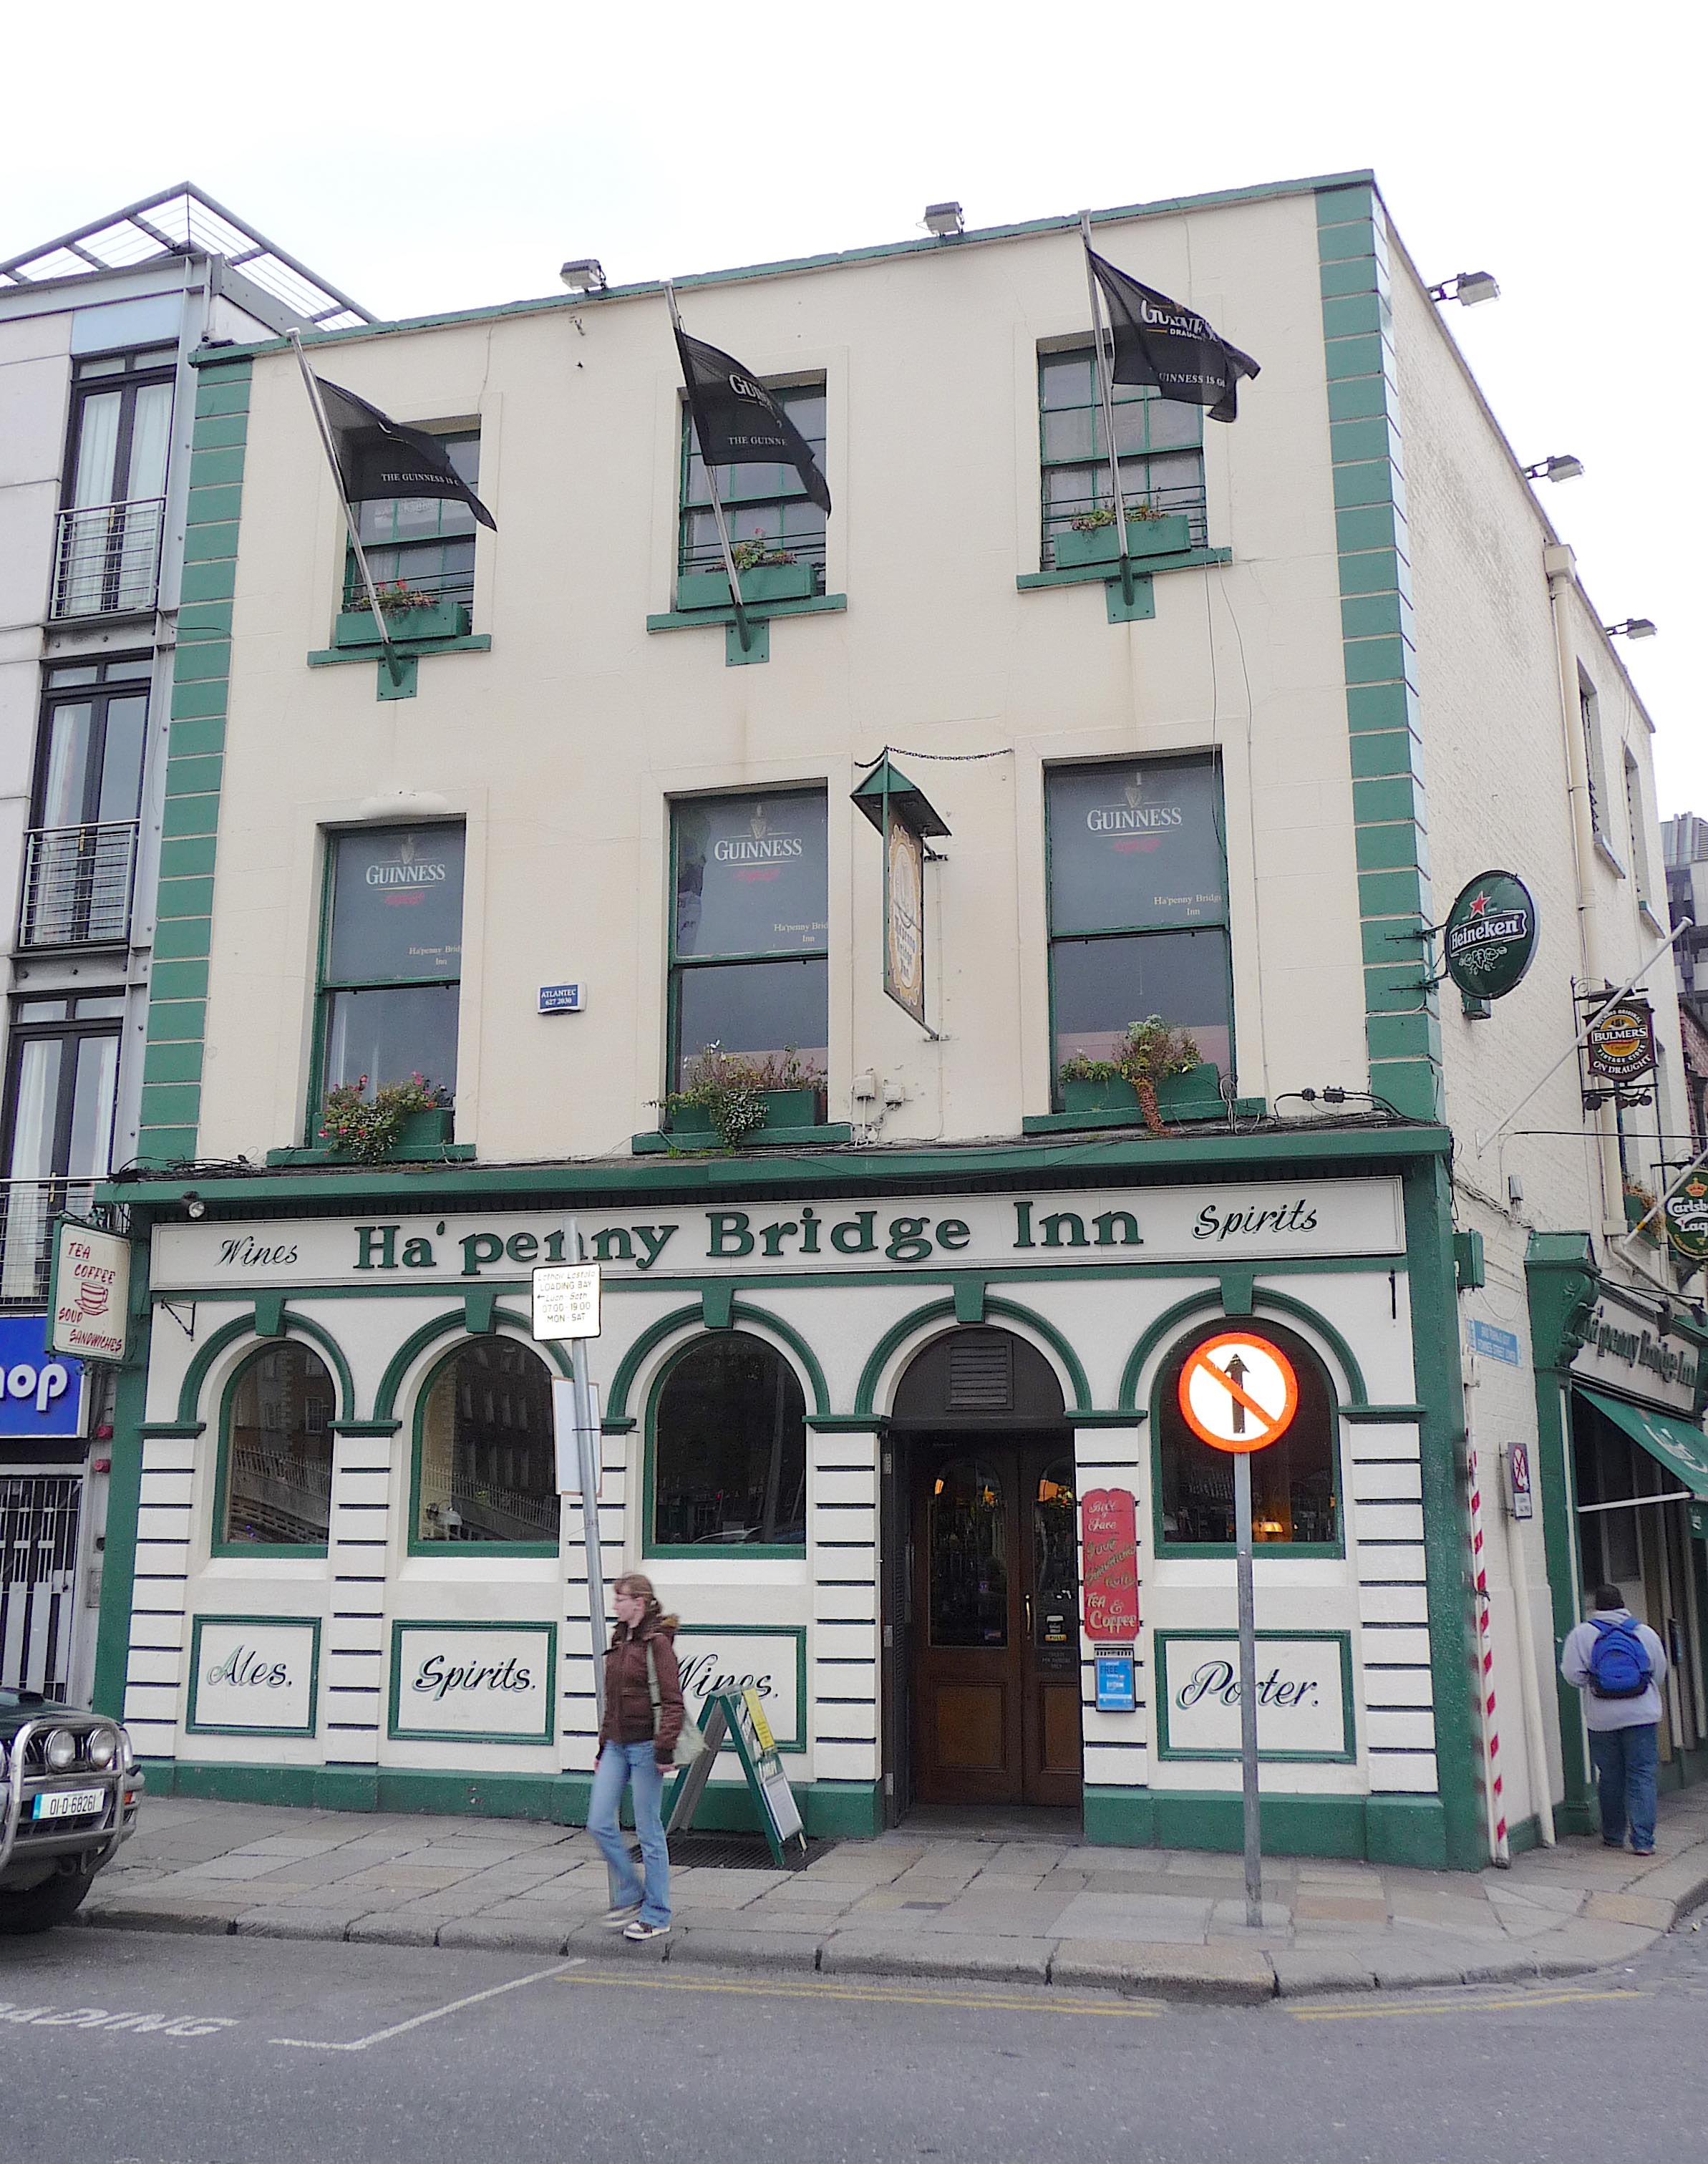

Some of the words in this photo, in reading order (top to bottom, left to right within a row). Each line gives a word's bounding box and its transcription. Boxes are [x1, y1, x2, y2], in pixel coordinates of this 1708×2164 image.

[1206, 375, 1215, 384] IS
[729, 436, 748, 445] THE
[382, 473, 400, 482] THE
[402, 473, 444, 483] GUINNESS
[1087, 807, 1182, 831] GUINNESS
[714, 838, 802, 860] GUINNESS
[366, 863, 445, 885] GUINNESS
[1154, 896, 1192, 906] Ha'penny
[1187, 908, 1200, 916] Inn
[774, 923, 810, 933] Ha'penny
[1452, 919, 1519, 950] Heineken
[436, 957, 447, 966] Inn
[541, 989, 576, 999] ATLANTEC
[1594, 1027, 1646, 1042] BULMERS
[1593, 1061, 1608, 1072] ON
[1608, 1054, 1651, 1074] DRAUGHT
[1191, 1199, 1318, 1241] Spirits
[706, 1207, 971, 1261] Bridge
[1013, 1200, 1144, 1248] Inn
[68, 1243, 90, 1259] TEA
[215, 1238, 299, 1266] Wines
[74, 1264, 115, 1284] COFFEE
[540, 1281, 574, 1291] LOADING
[578, 1281, 591, 1289] BAY
[59, 1307, 83, 1324] SOUP
[547, 1314, 565, 1323] MON
[571, 1312, 586, 1321] SAT
[69, 1329, 122, 1352] SANDWICHES
[0, 1364, 67, 1411] op
[1110, 1599, 1124, 1614] &
[1090, 1610, 1137, 1634] Coffee
[412, 1654, 537, 1702] Spirits.
